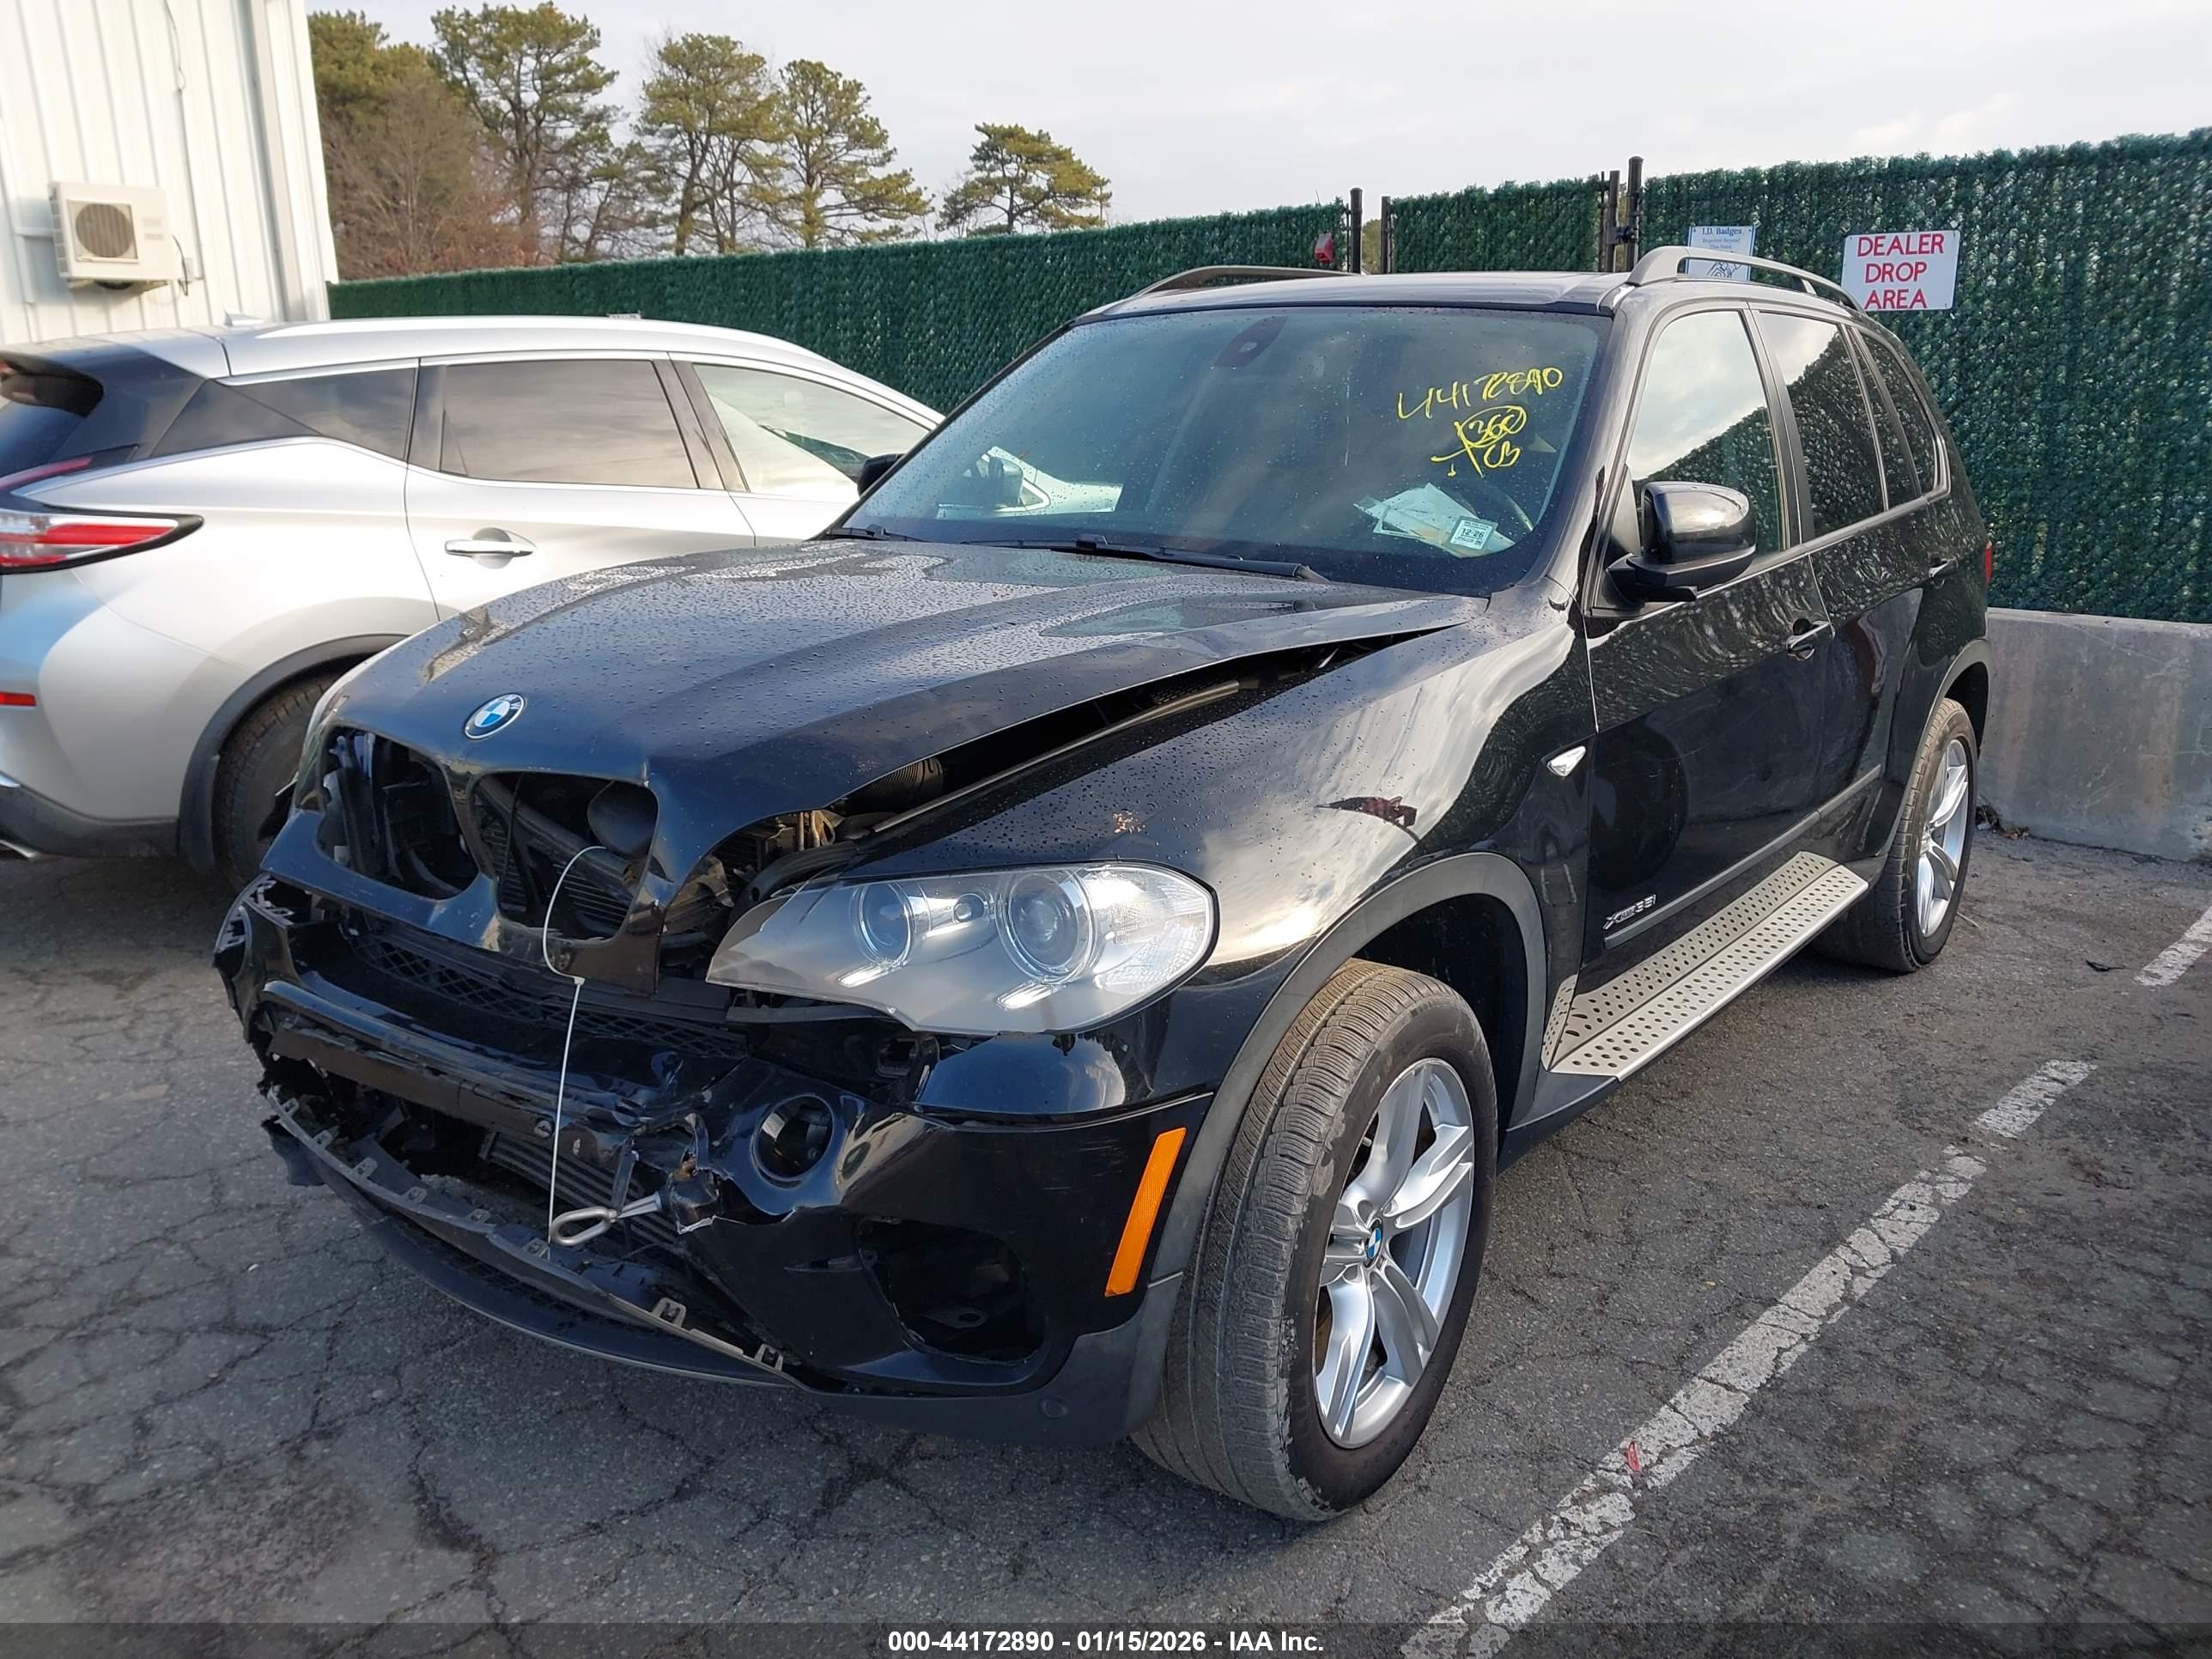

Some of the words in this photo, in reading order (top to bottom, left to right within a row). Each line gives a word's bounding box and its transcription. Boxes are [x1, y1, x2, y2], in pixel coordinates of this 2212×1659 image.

[1717, 228, 1742, 237] Badges
[1857, 234, 1945, 257] DEALER
[1865, 261, 1928, 283] DROP
[1864, 289, 1928, 310] AREA
